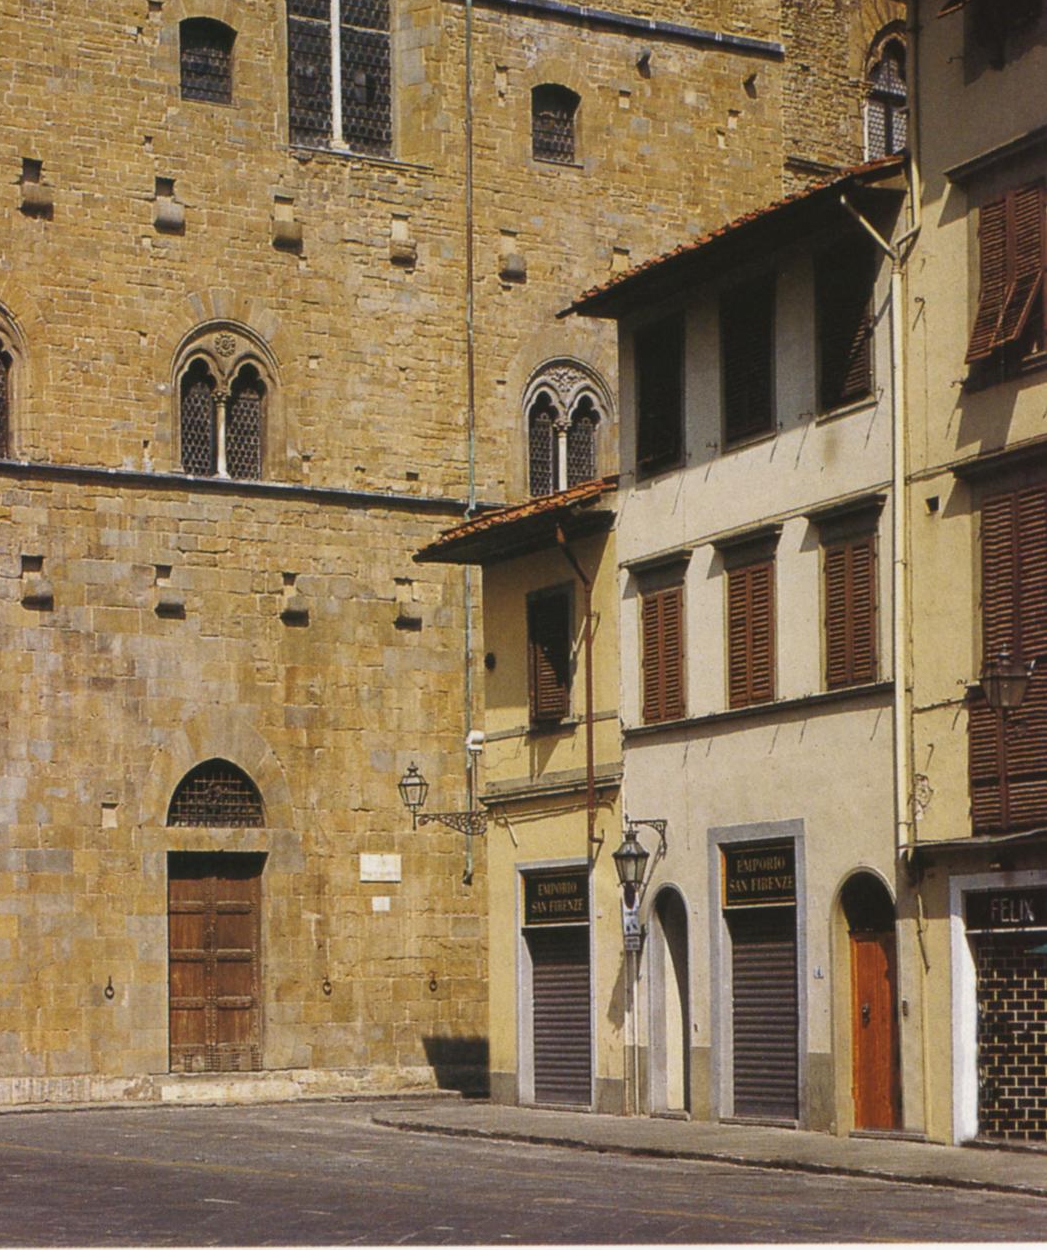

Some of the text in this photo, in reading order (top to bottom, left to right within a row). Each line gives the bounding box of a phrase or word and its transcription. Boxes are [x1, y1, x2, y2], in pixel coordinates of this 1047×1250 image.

[737, 856, 785, 873] EMPORIO
[538, 881, 577, 896] EMPORIO
[729, 875, 794, 894] SAN FIRENZE
[531, 898, 583, 913] SAN FIRENZE
[991, 897, 1035, 922] FELIX
